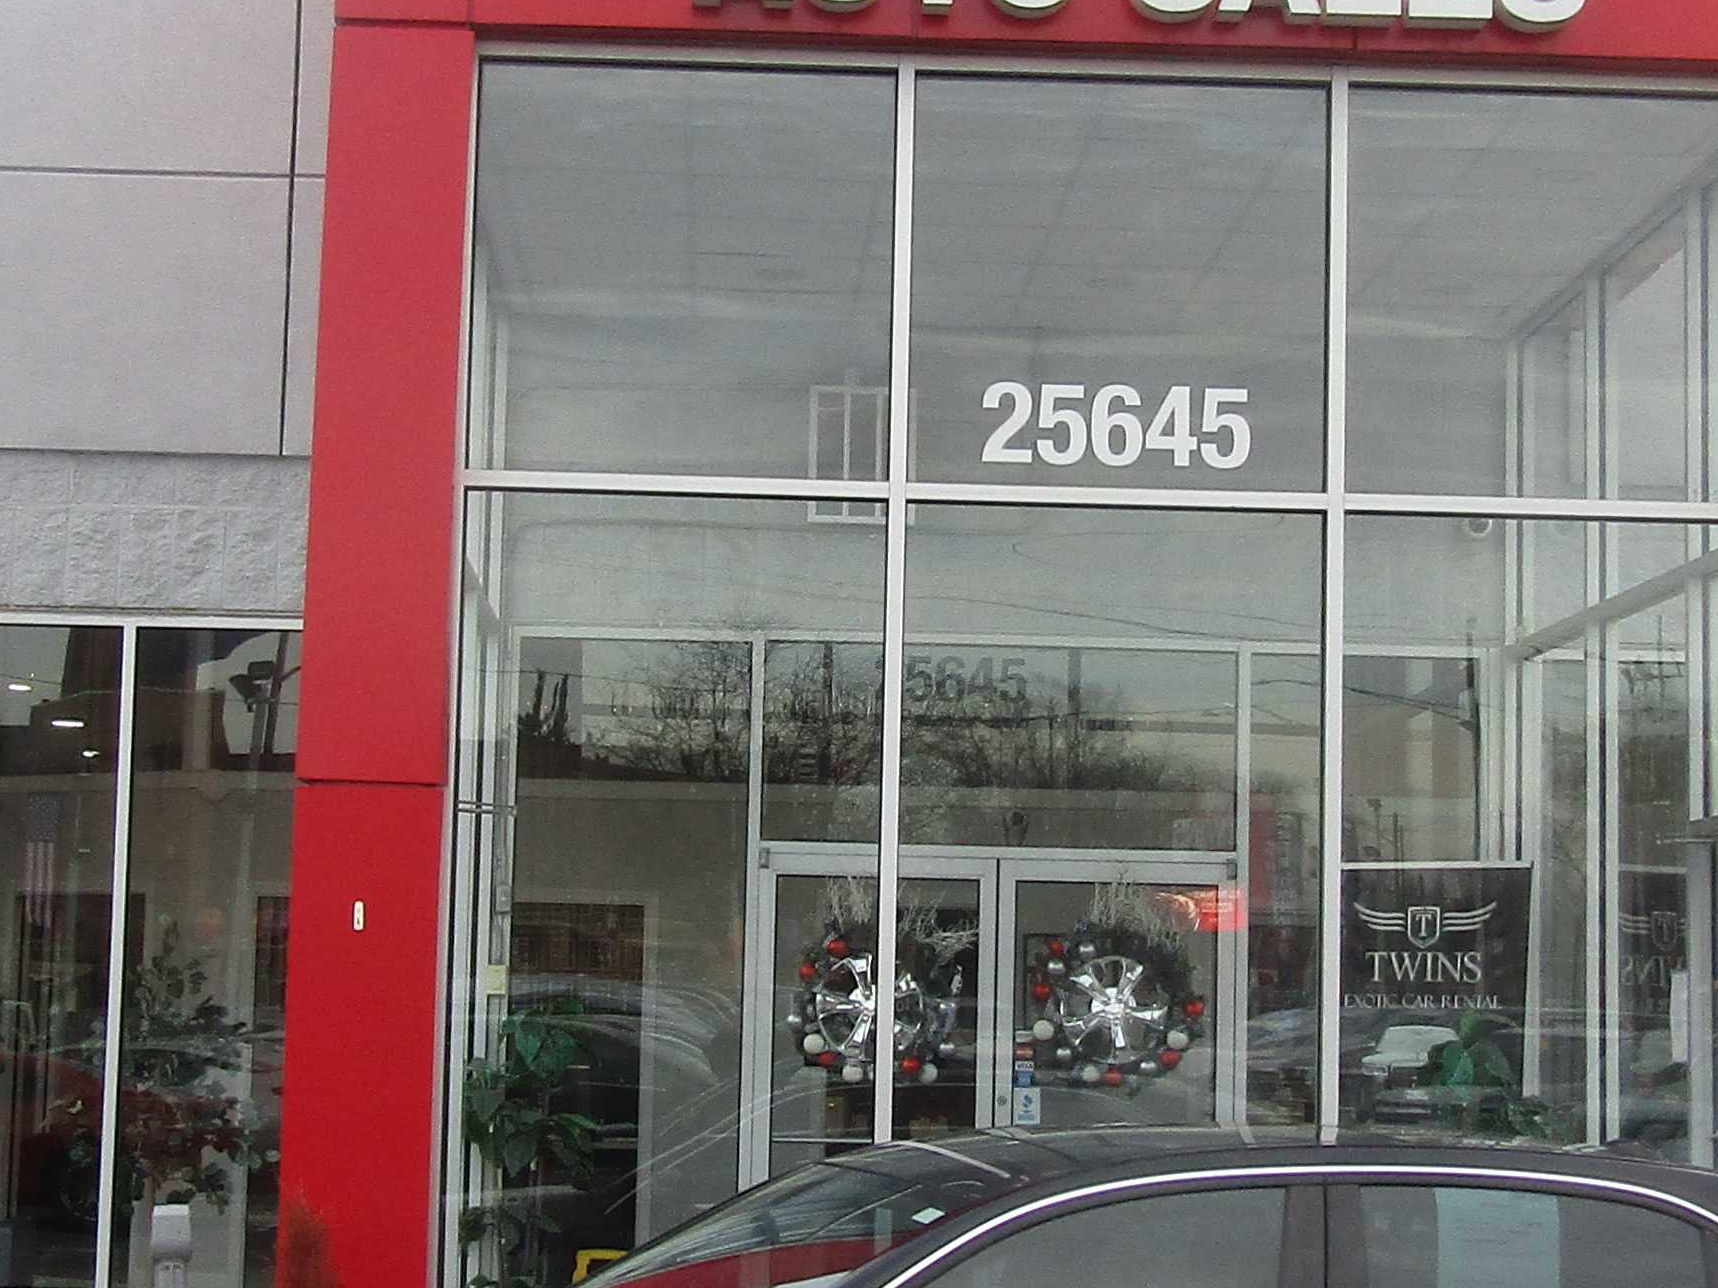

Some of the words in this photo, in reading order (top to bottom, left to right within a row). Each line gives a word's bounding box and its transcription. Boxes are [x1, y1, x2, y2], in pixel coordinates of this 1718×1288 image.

[981, 380, 1252, 469] 25645
[876, 655, 1029, 705] 5645
[1414, 913, 1431, 938] T
[1365, 950, 1483, 984] TWINS
[1343, 993, 1400, 1009] EXOTIC
[1402, 993, 1435, 1009] CAR
[1440, 994, 1503, 1010] RENTAL
